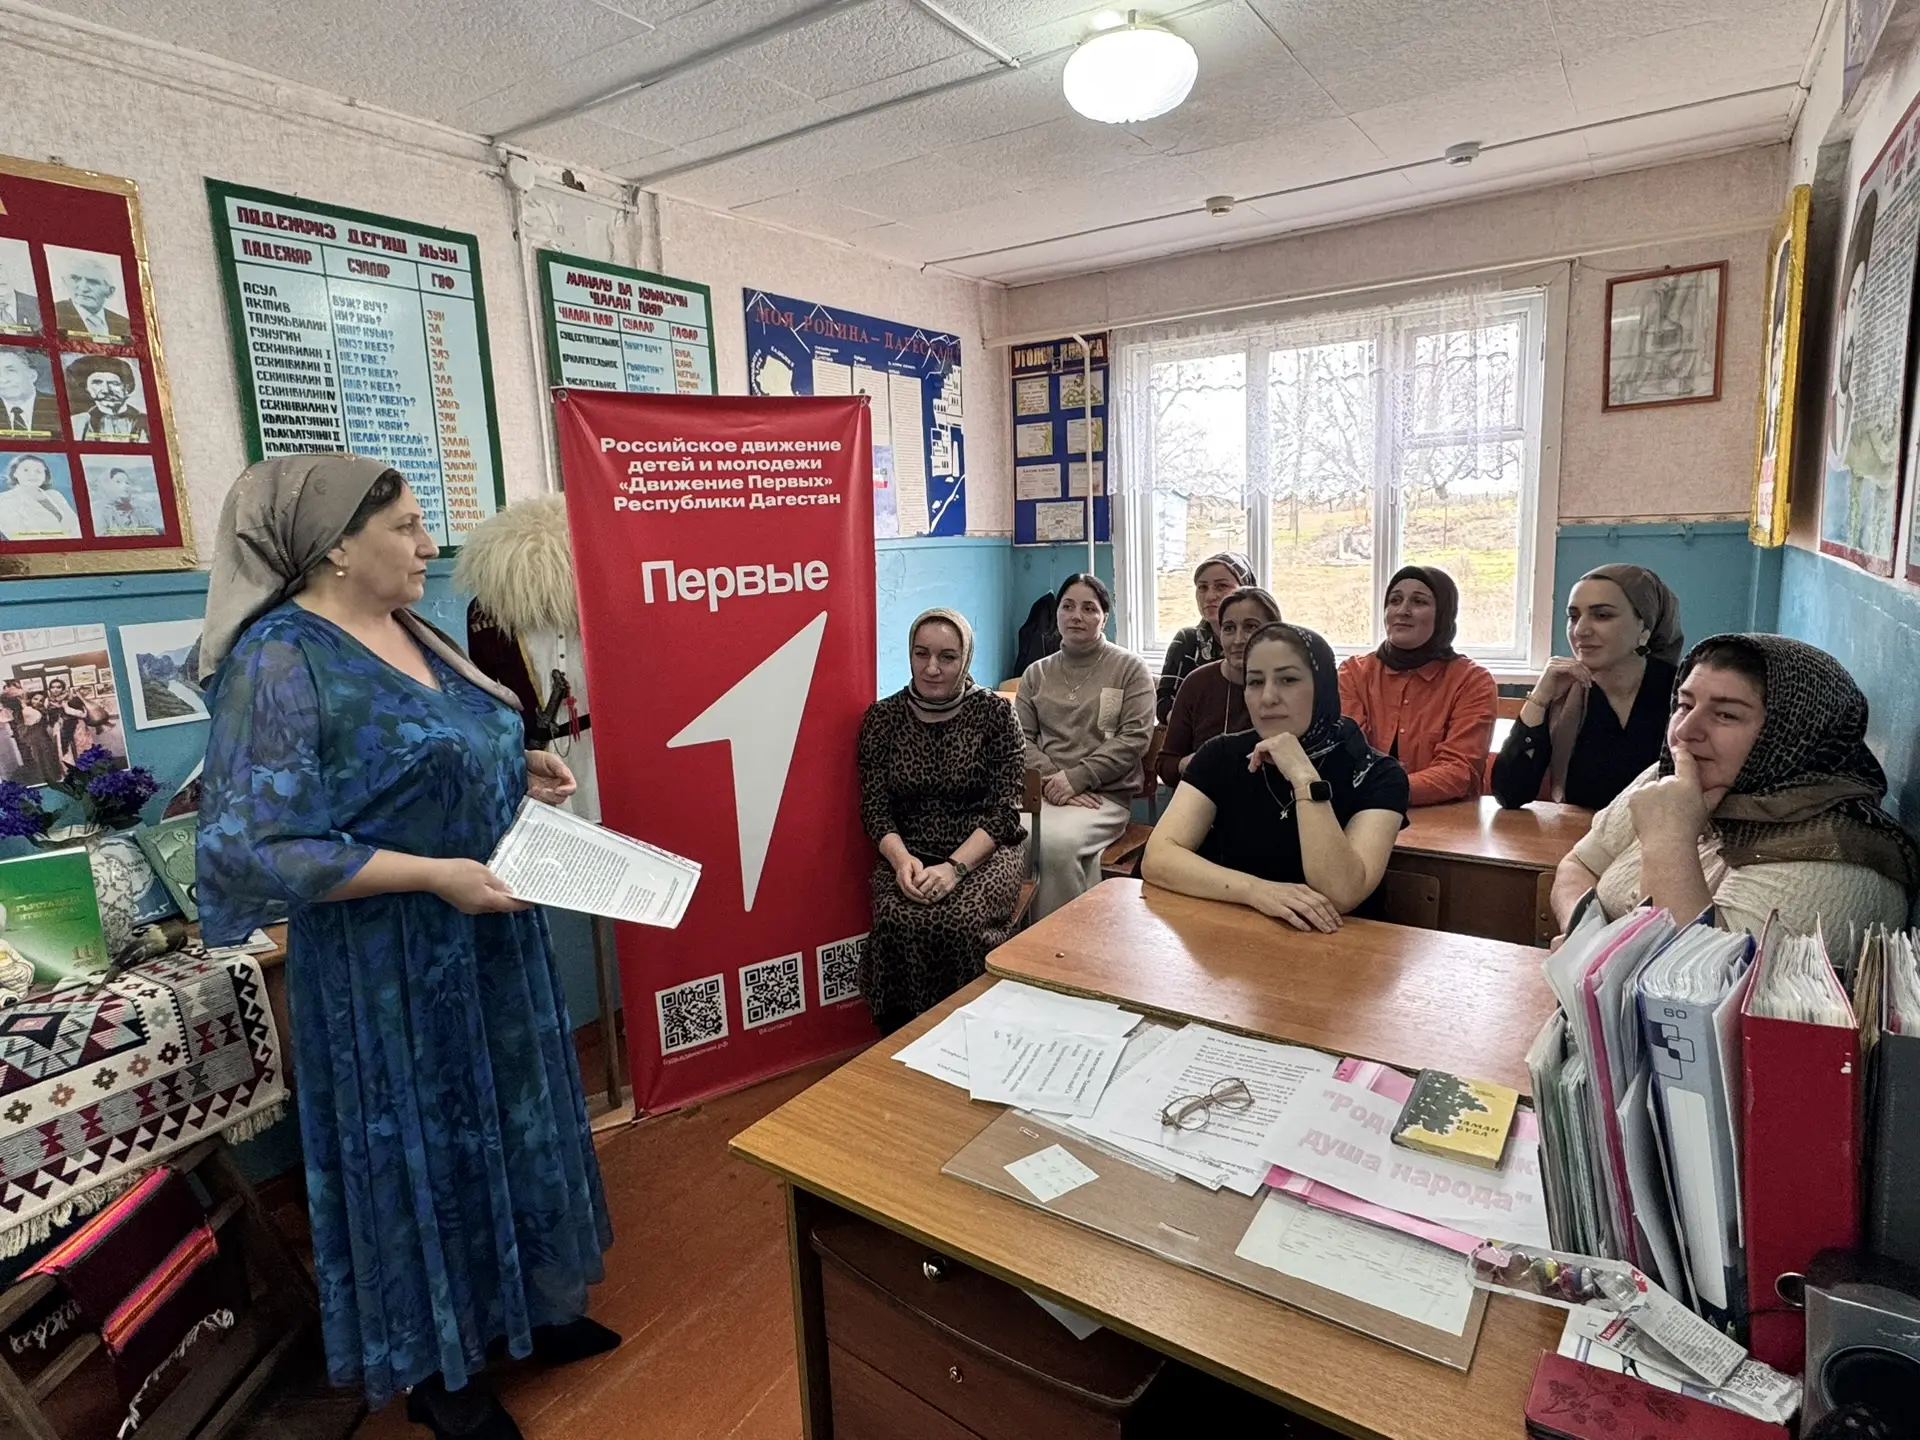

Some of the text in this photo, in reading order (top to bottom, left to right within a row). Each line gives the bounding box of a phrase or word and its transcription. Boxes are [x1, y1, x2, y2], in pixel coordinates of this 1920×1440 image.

[237, 206, 337, 240] ПАДЕЖРИЗ
[347, 228, 408, 254] ДЕГИШ
[242, 239, 312, 265] ПАДЕЖАР
[243, 282, 277, 297] АСУЛ
[431, 273, 455, 290] ГАФ
[618, 282, 633, 297] ВА
[245, 297, 291, 314] АКТИВ
[250, 326, 302, 343] ГУНУГИН
[623, 318, 655, 333] СУАЛАР
[671, 326, 698, 341] ГАФАР
[755, 306, 794, 328] МОЯ
[804, 315, 869, 345] РОДИНА
[600, 437, 842, 455] Российское движение
[628, 456, 822, 475] детей и молодежи
[619, 474, 833, 494] «Движение Первых»
[613, 493, 841, 513] Республики Дагестан
[641, 560, 829, 612] Первые
[1299, 1127, 1381, 1174] душа
[1389, 1162, 1533, 1213] народа"
